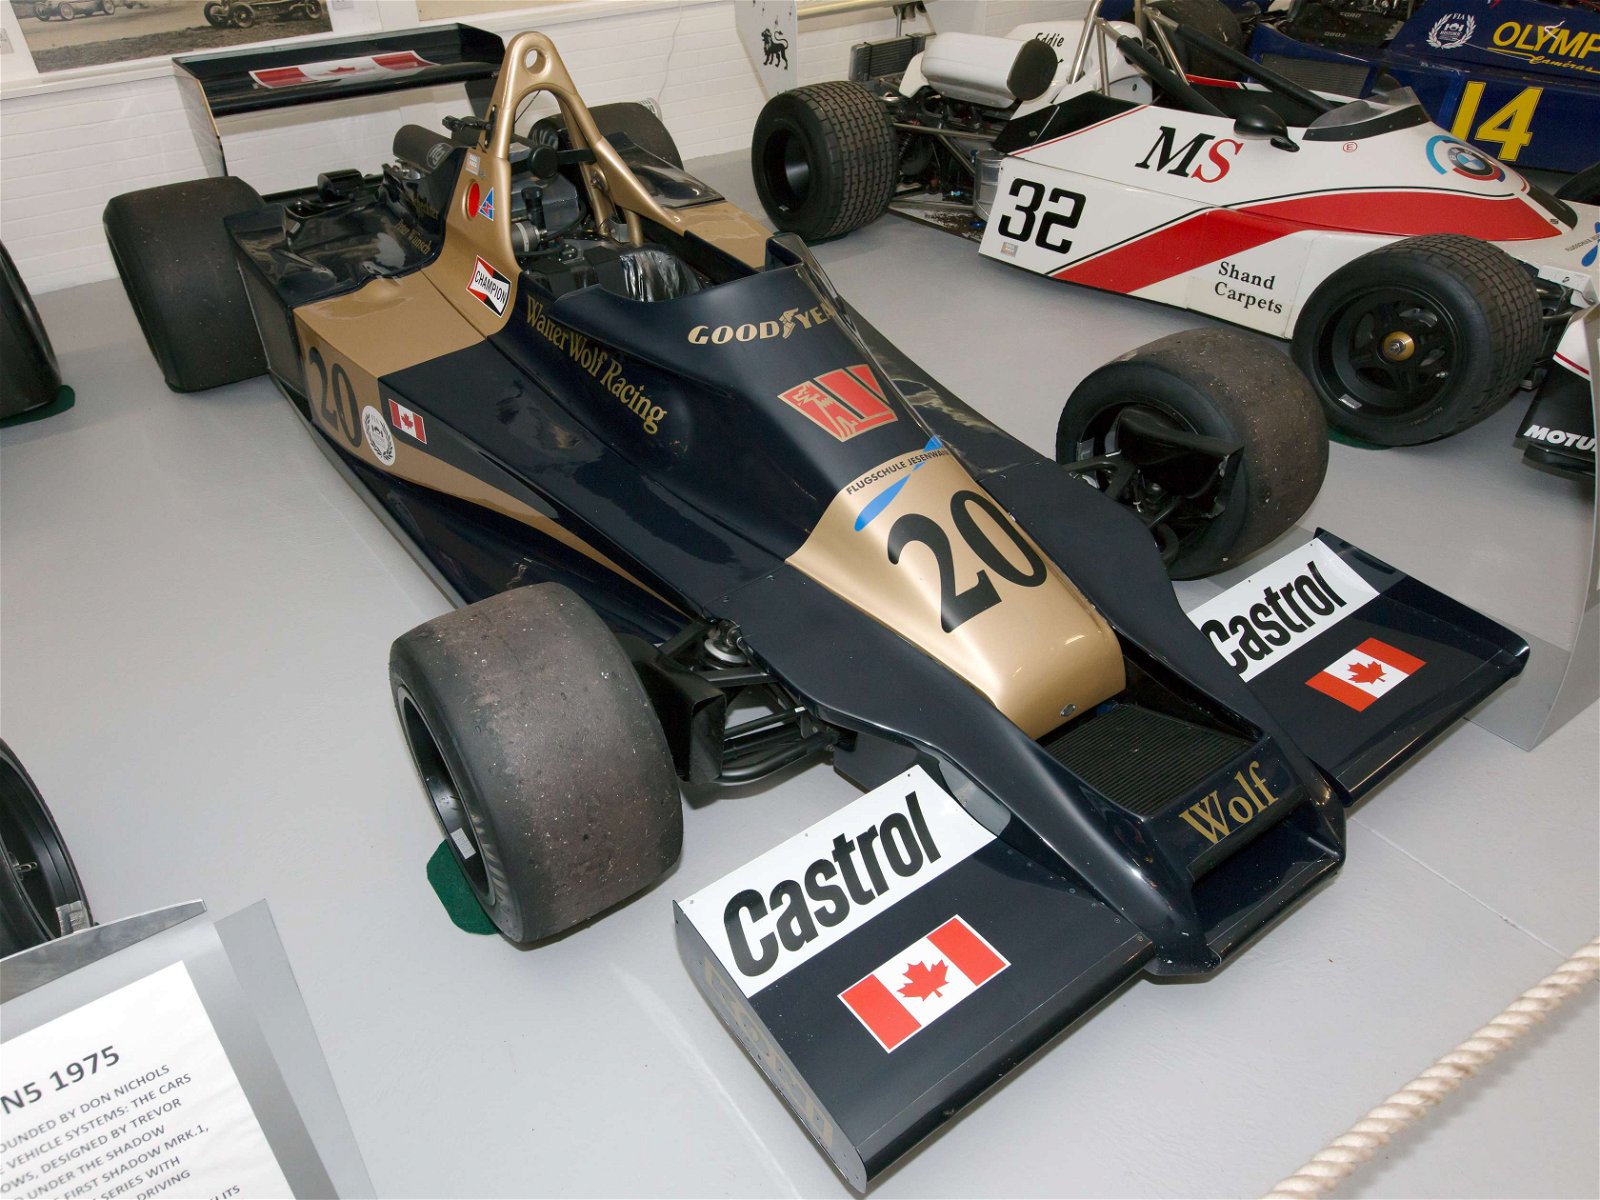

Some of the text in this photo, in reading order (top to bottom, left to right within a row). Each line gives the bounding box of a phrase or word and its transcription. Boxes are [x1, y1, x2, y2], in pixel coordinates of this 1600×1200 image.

[1135, 126, 1244, 183] MS
[1451, 81, 1544, 161] 14
[998, 178, 1086, 254] 32
[474, 270, 507, 304] CHAMPION
[1214, 281, 1283, 315] Carpets
[1218, 261, 1276, 290] Shand
[687, 300, 837, 345] GOODYEA
[309, 346, 362, 448] 20
[569, 331, 607, 377] Wolf
[600, 358, 668, 435] Racing
[846, 449, 950, 495] FLUGSCHULE JESENWAN
[887, 490, 1048, 633] 20
[1200, 560, 1348, 674] Castrol
[1179, 761, 1279, 846] Wolf
[723, 790, 942, 977] Castrol
[50, 1045, 119, 1091] 1975
[59, 1109, 76, 1123] BY
[80, 1093, 111, 1113] DON
[114, 1065, 170, 1097] NICHOLS
[7, 1074, 192, 1169] VEHICLE SYSTEMS: THE CARS
[41, 1136, 108, 1174] DESIGNED
[110, 1125, 127, 1139] BY
[129, 1098, 182, 1128] TREVOR
[27, 1125, 165, 1199] UNDER THE SHADOW
[64, 1124, 209, 1200] FIRST SHADOW MRK.1,
[101, 1156, 181, 1200] SERIES WITH
[136, 1169, 191, 1200] DRIVING
[222, 1184, 241, 1199] ITS
